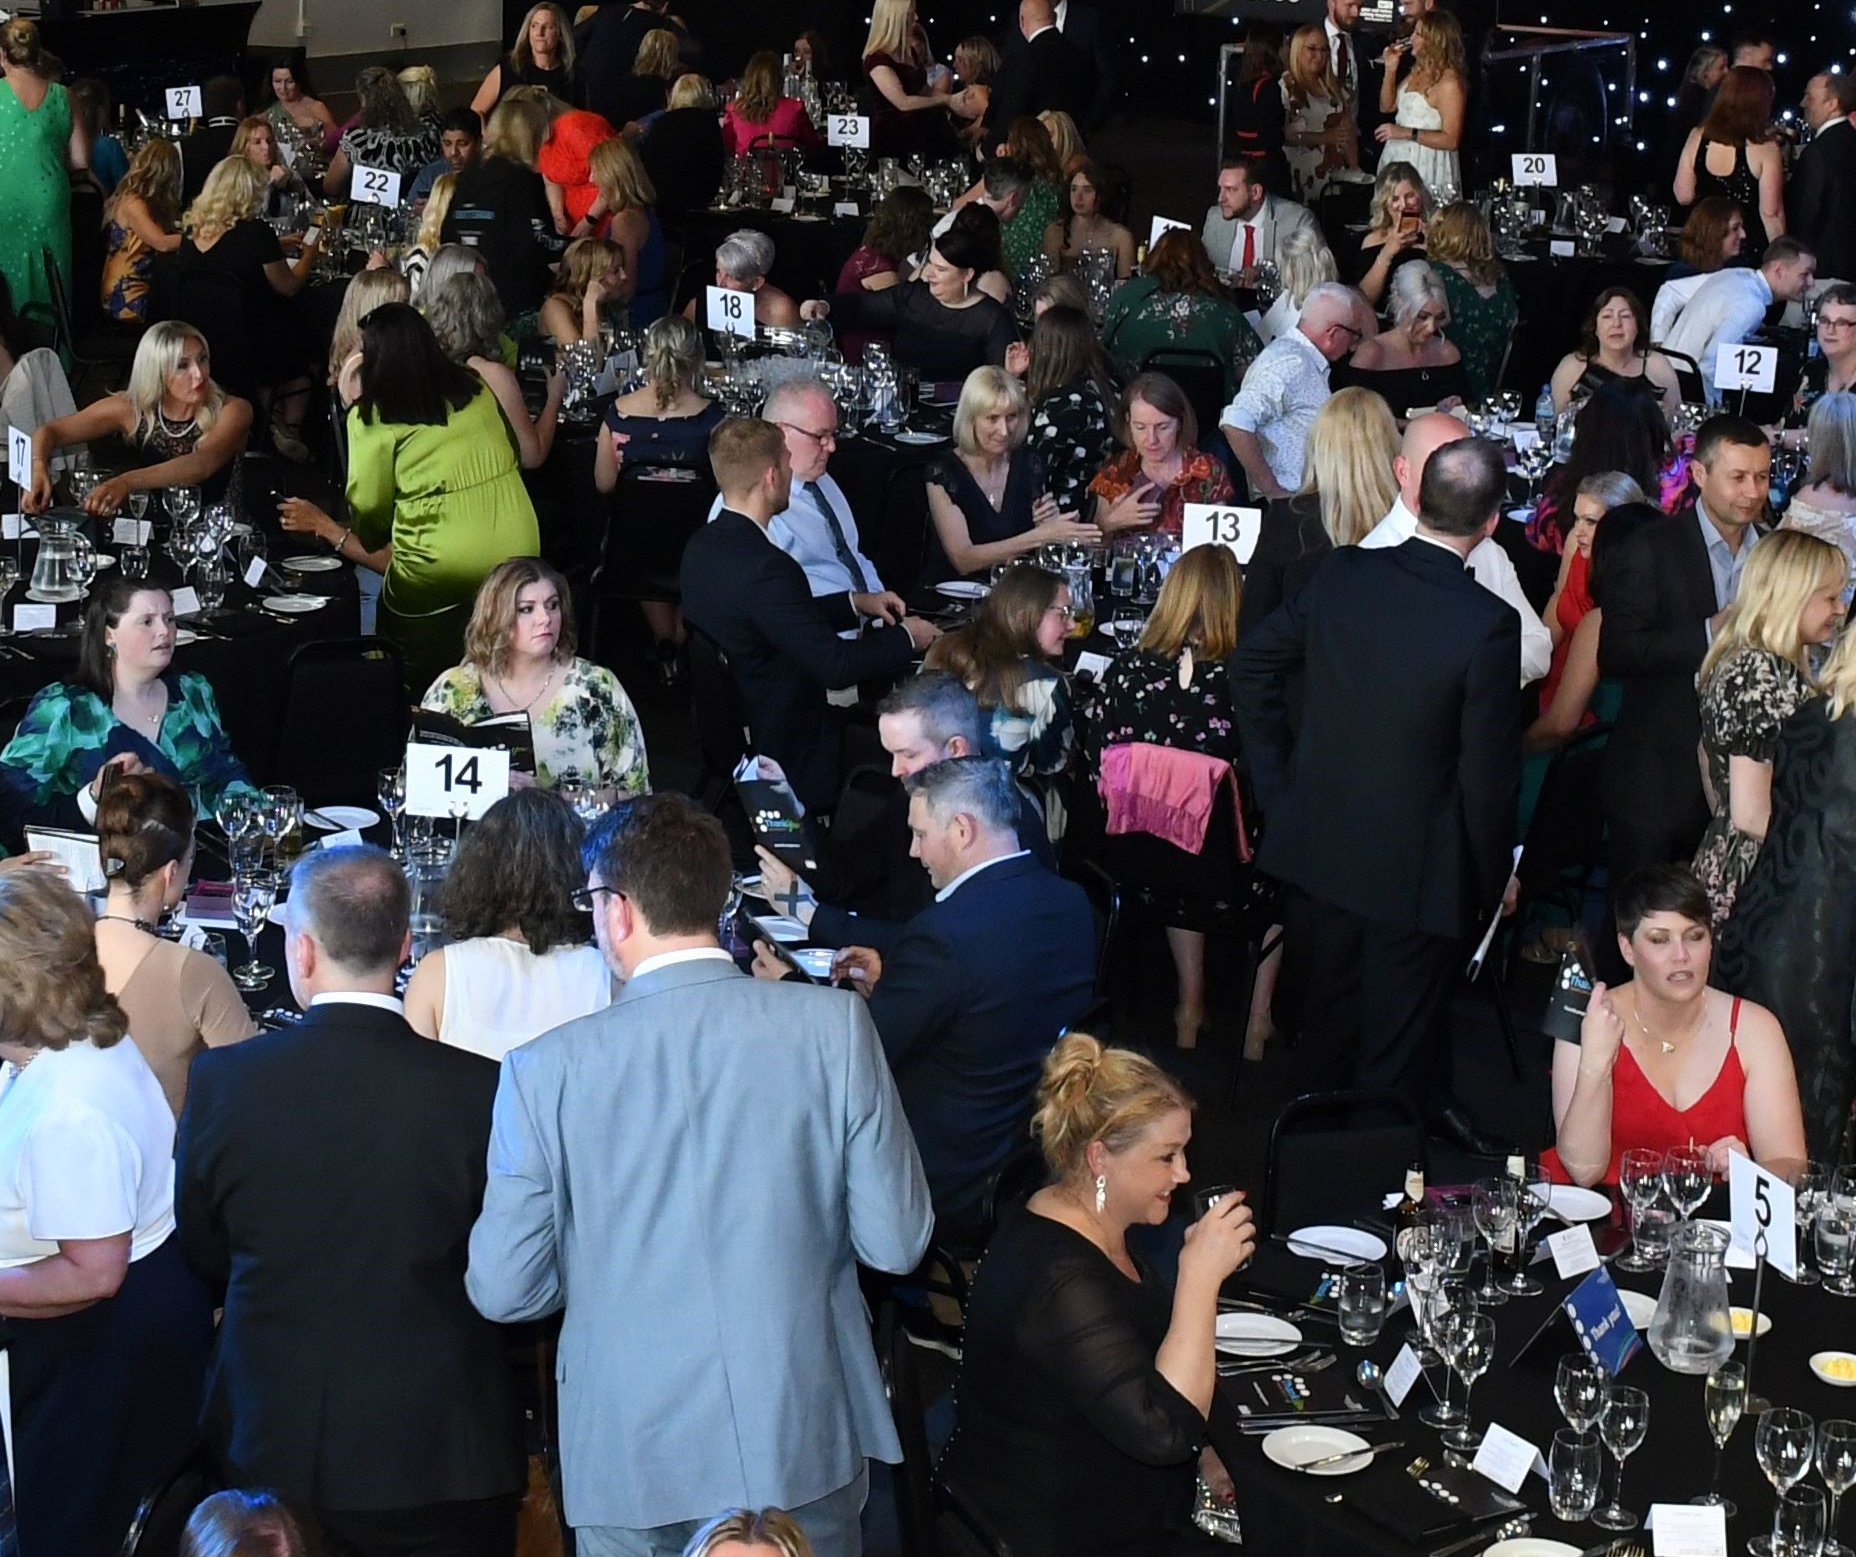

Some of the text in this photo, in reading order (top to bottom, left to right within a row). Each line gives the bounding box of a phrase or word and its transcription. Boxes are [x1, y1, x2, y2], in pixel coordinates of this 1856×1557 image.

[174, 90, 192, 109] 27
[837, 118, 859, 136] 23
[1523, 157, 1546, 174] 20
[363, 171, 389, 193] 22
[719, 293, 742, 319] 18
[1734, 349, 1761, 376] 12
[15, 436, 26, 467] 17
[1205, 511, 1240, 543] 13
[435, 753, 483, 794] 14
[1755, 1174, 1771, 1228] 5
